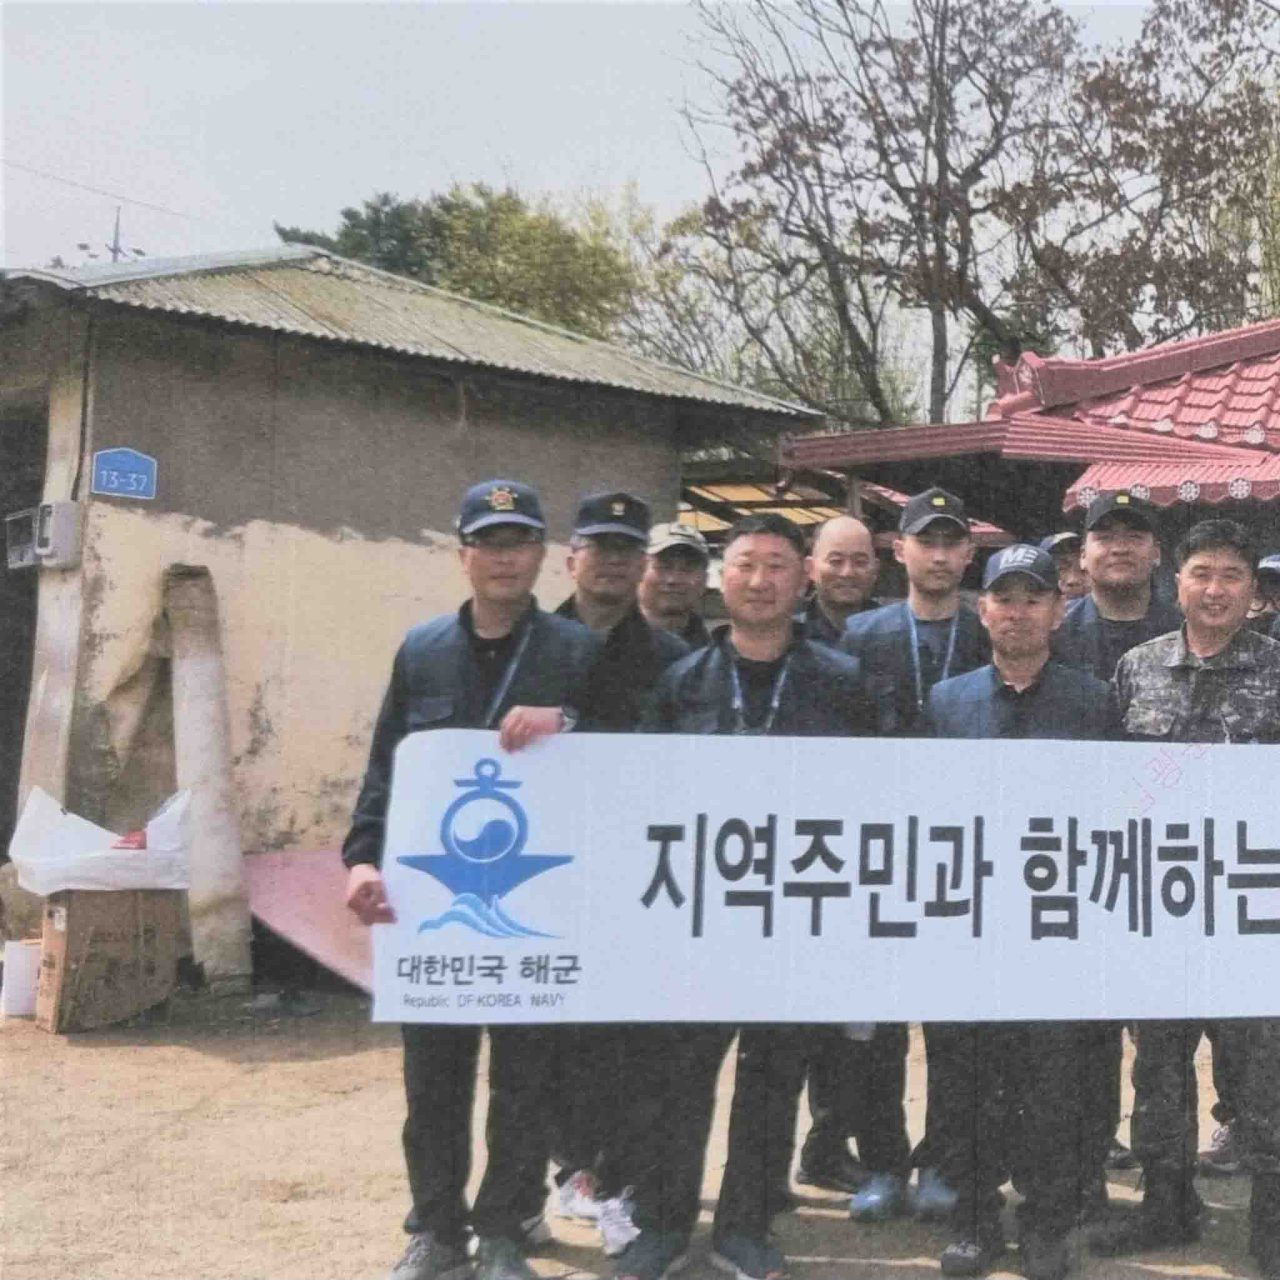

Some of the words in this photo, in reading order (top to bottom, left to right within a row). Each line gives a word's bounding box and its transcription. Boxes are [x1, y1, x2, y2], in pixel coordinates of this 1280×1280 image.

[100, 469, 148, 491] 13-37
[639, 813, 994, 939] 지역주민과
[397, 954, 509, 986] 대한민국
[519, 954, 583, 985] 해군
